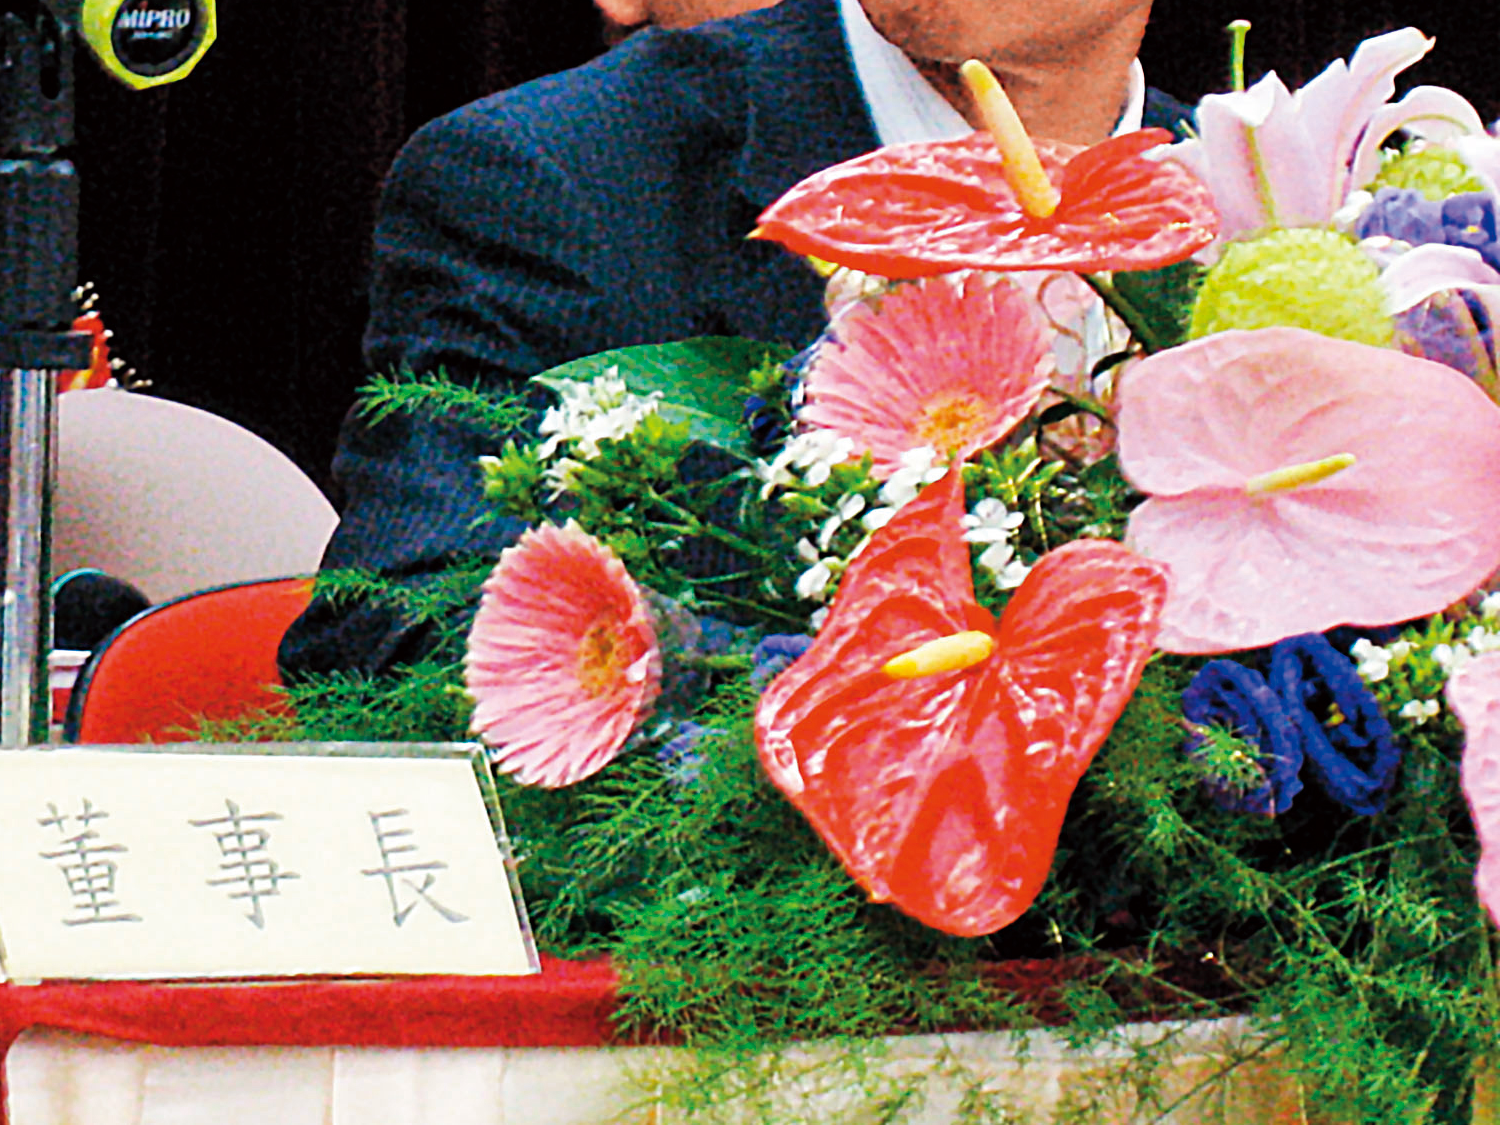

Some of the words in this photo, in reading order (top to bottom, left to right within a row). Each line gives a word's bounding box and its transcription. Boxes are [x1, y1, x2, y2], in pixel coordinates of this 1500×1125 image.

[117, 8, 191, 29] MIPRO
[37, 798, 470, 929] 董事長
